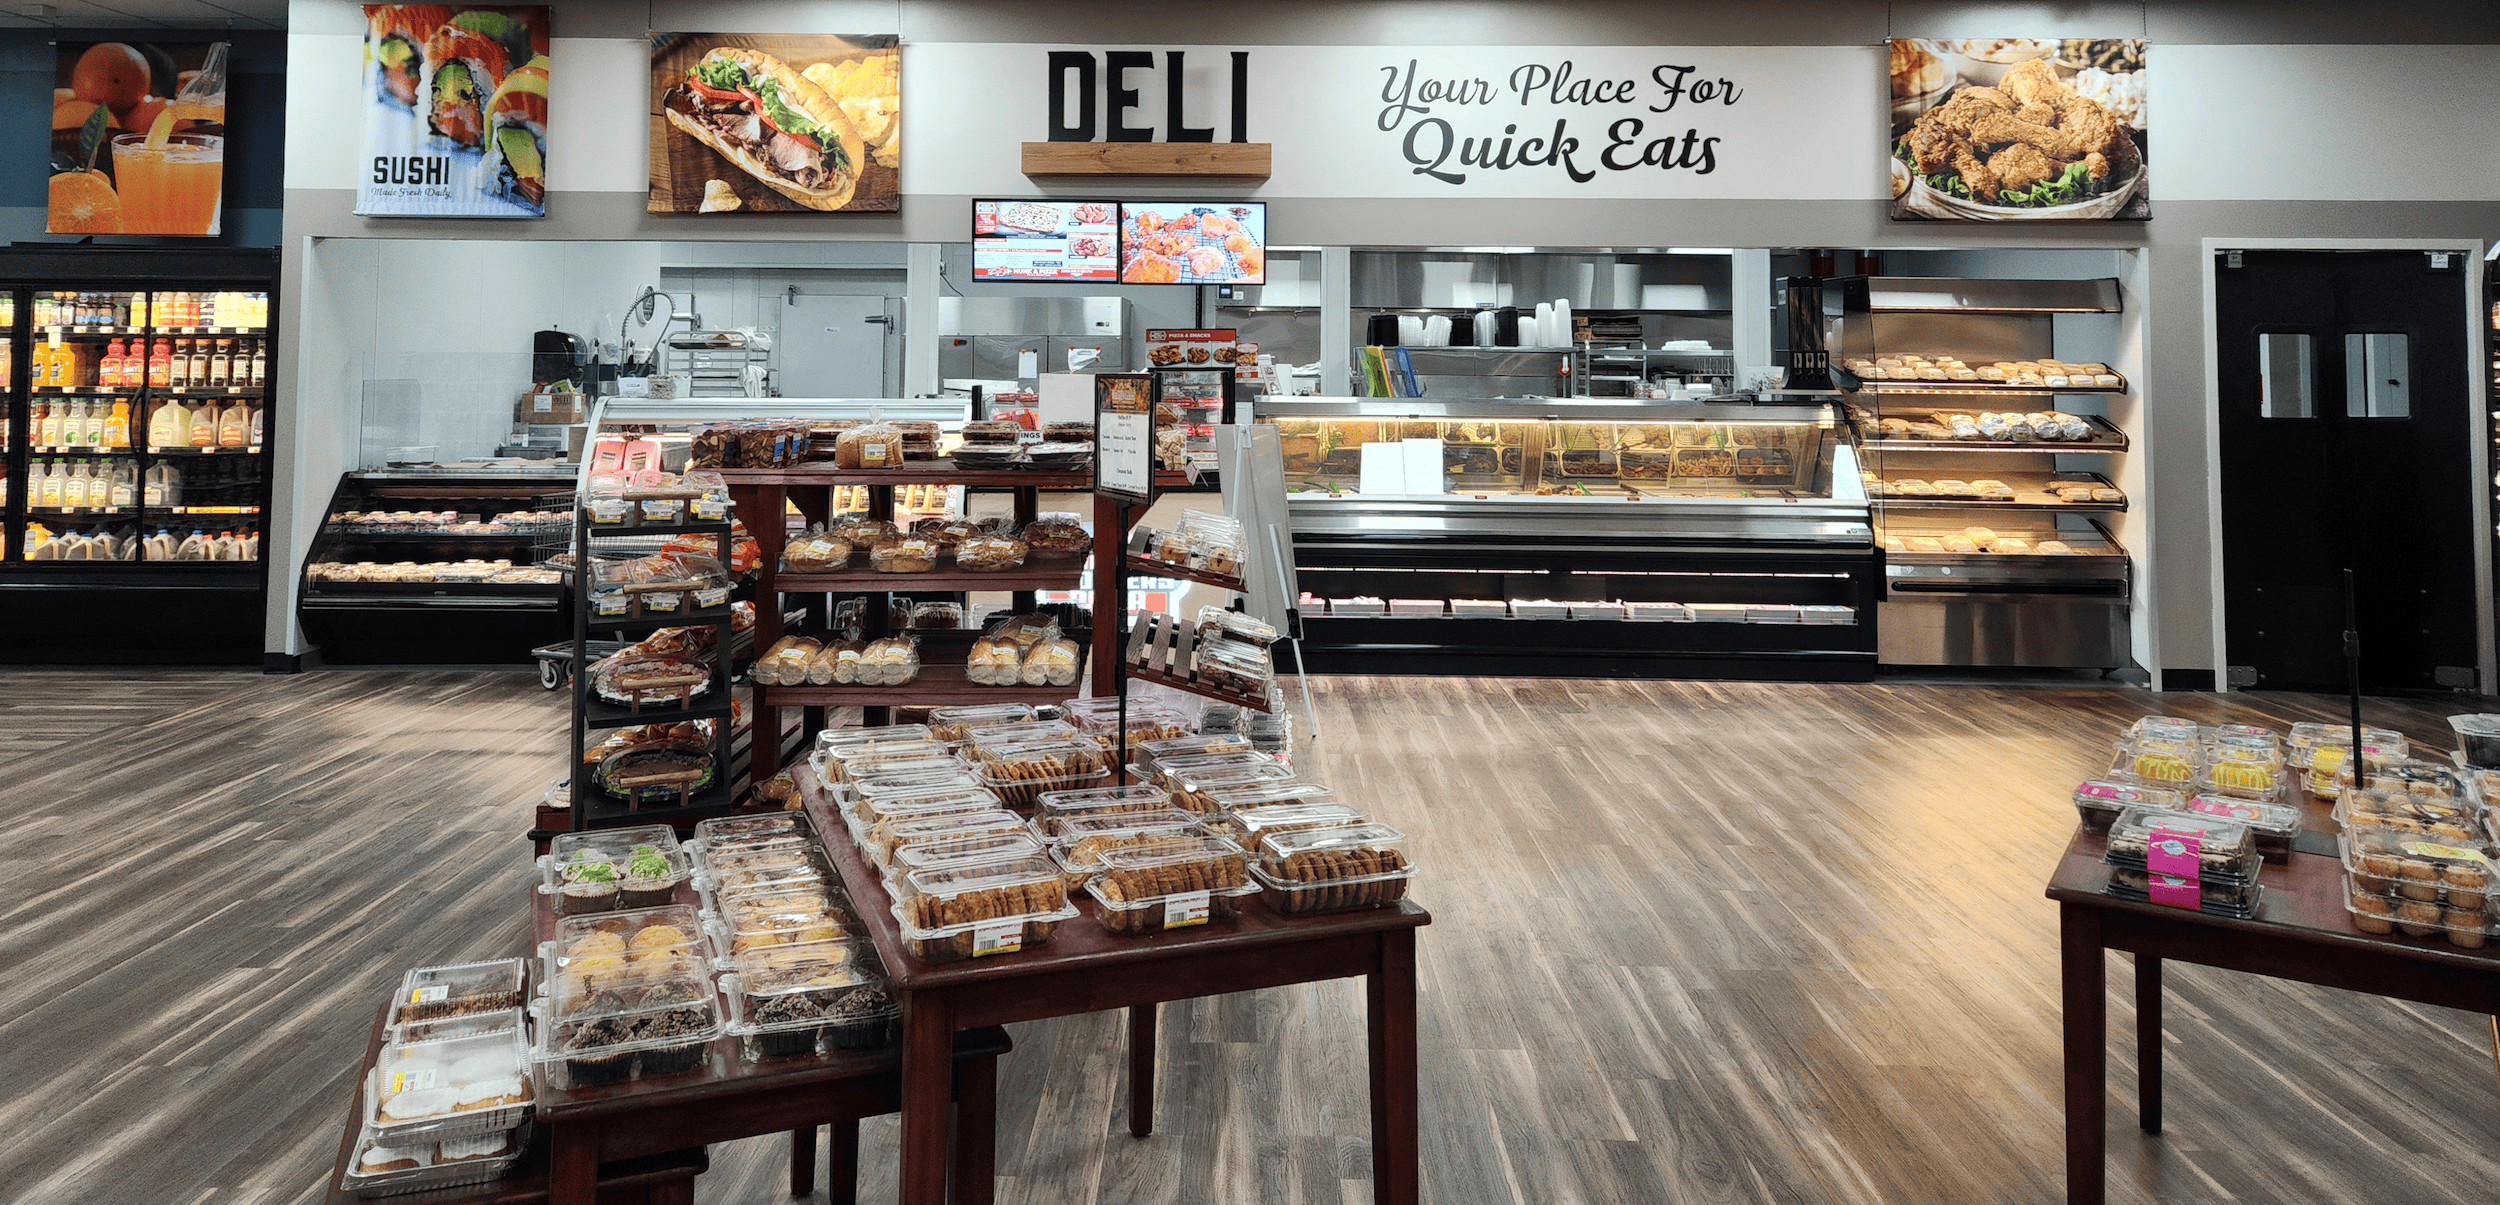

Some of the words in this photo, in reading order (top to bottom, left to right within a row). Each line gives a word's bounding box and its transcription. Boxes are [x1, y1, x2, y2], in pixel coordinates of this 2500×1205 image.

[1047, 50, 1249, 143] DELI
[1377, 60, 1497, 132] Your
[1510, 60, 1636, 106] Place
[1649, 64, 1744, 113] For
[373, 156, 450, 185] SUSHI
[1402, 117, 1596, 185] Quick
[1600, 117, 1721, 175] Eats
[371, 187, 397, 197] Made
[398, 187, 422, 198] Fresh
